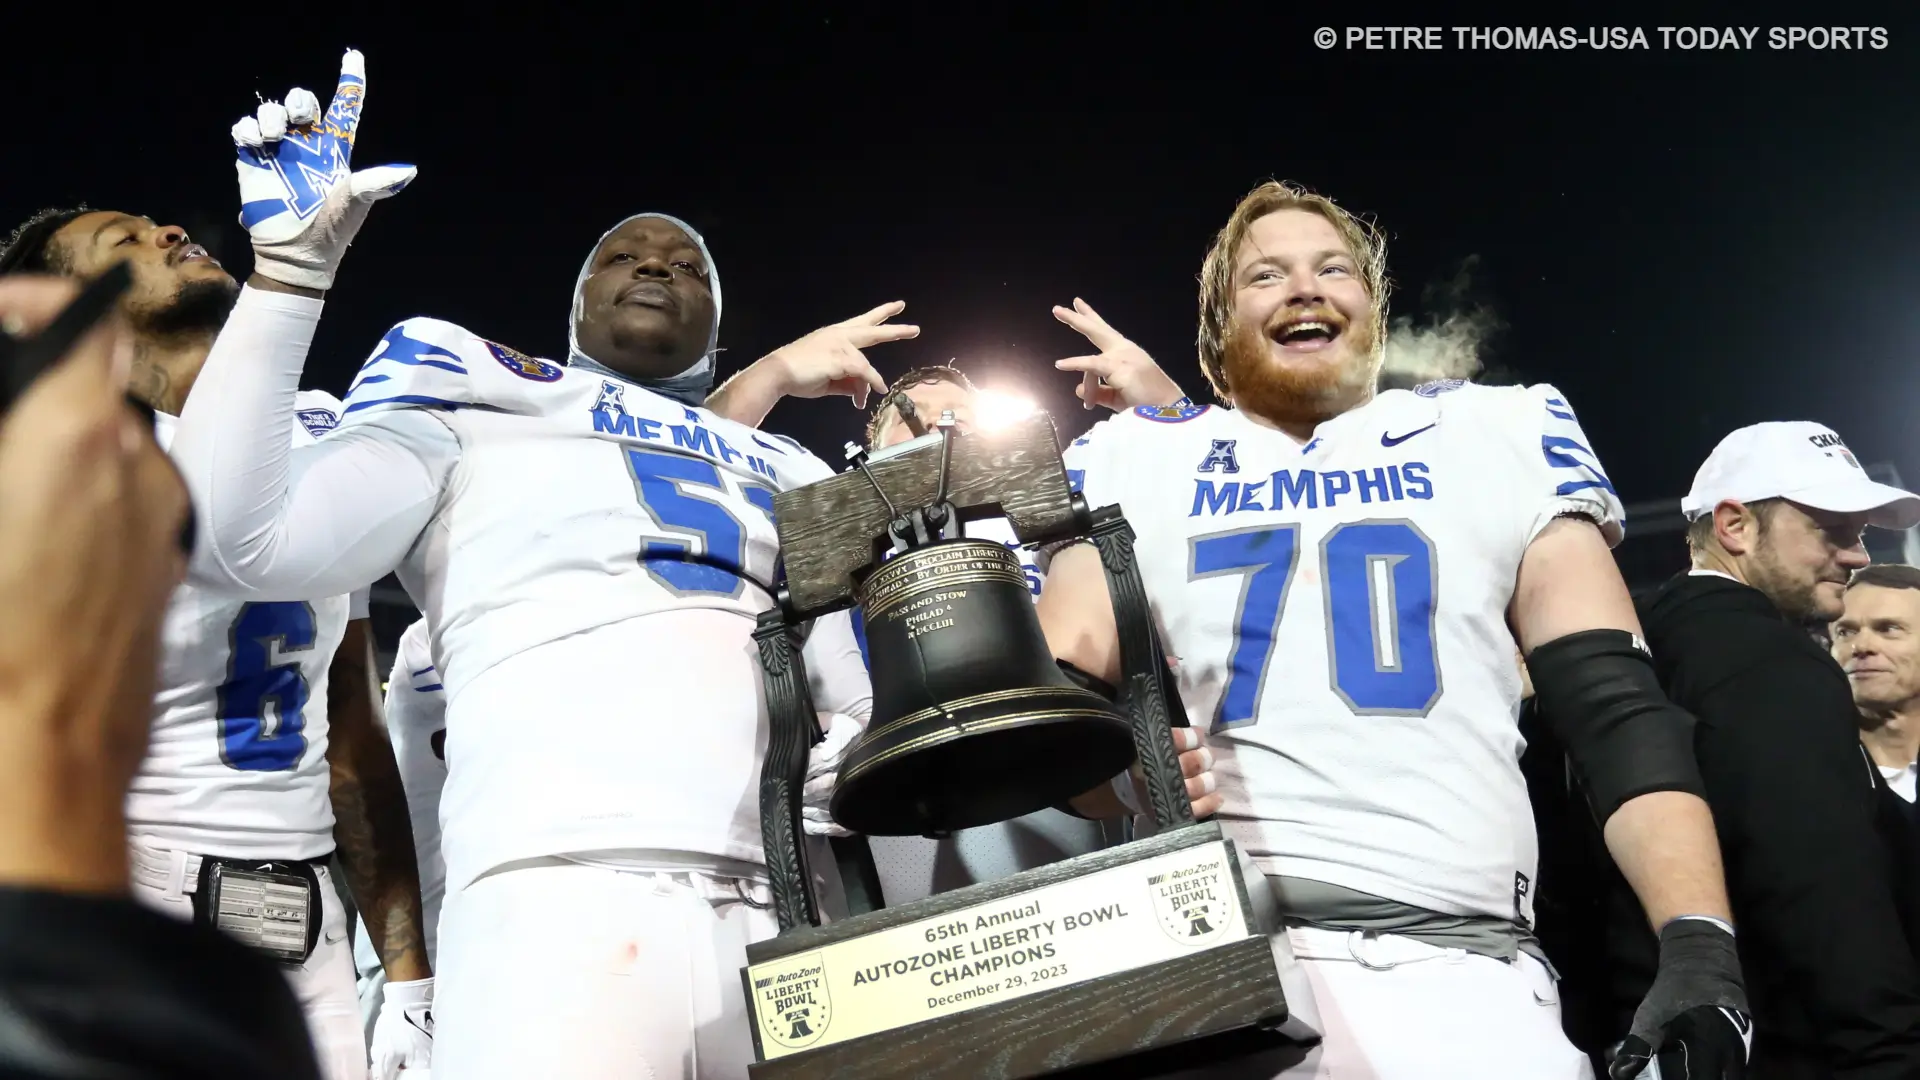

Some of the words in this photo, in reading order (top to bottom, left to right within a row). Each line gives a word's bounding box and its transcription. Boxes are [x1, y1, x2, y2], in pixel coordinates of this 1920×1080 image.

[1188, 461, 1434, 517] MEMPHIS
[619, 442, 778, 601] 5
[914, 551, 963, 568] PROCLAIM
[916, 570, 930, 580] BY
[934, 563, 968, 575] ORDER
[910, 597, 933, 611] AND
[935, 590, 967, 603] STOW
[1187, 517, 1444, 736] 70
[215, 600, 318, 772] 6
[1171, 861, 1220, 880] AutoZone
[1160, 873, 1218, 898] LIBERTY
[1170, 887, 1217, 912] BOWL
[924, 920, 969, 943] 65th
[974, 900, 1042, 930] Annual
[852, 943, 966, 987] AUTOZONE
[970, 920, 1056, 956] LIBERTY
[1062, 902, 1129, 932] BOWL
[776, 966, 822, 984] AutoZone
[929, 942, 1057, 987] CHAMPIONS
[765, 977, 820, 1000] LIBERTY
[927, 981, 1000, 1010] December
[1004, 974, 1028, 990] 29,
[1031, 963, 1069, 983] 2023
[774, 991, 818, 1015] BOWL
